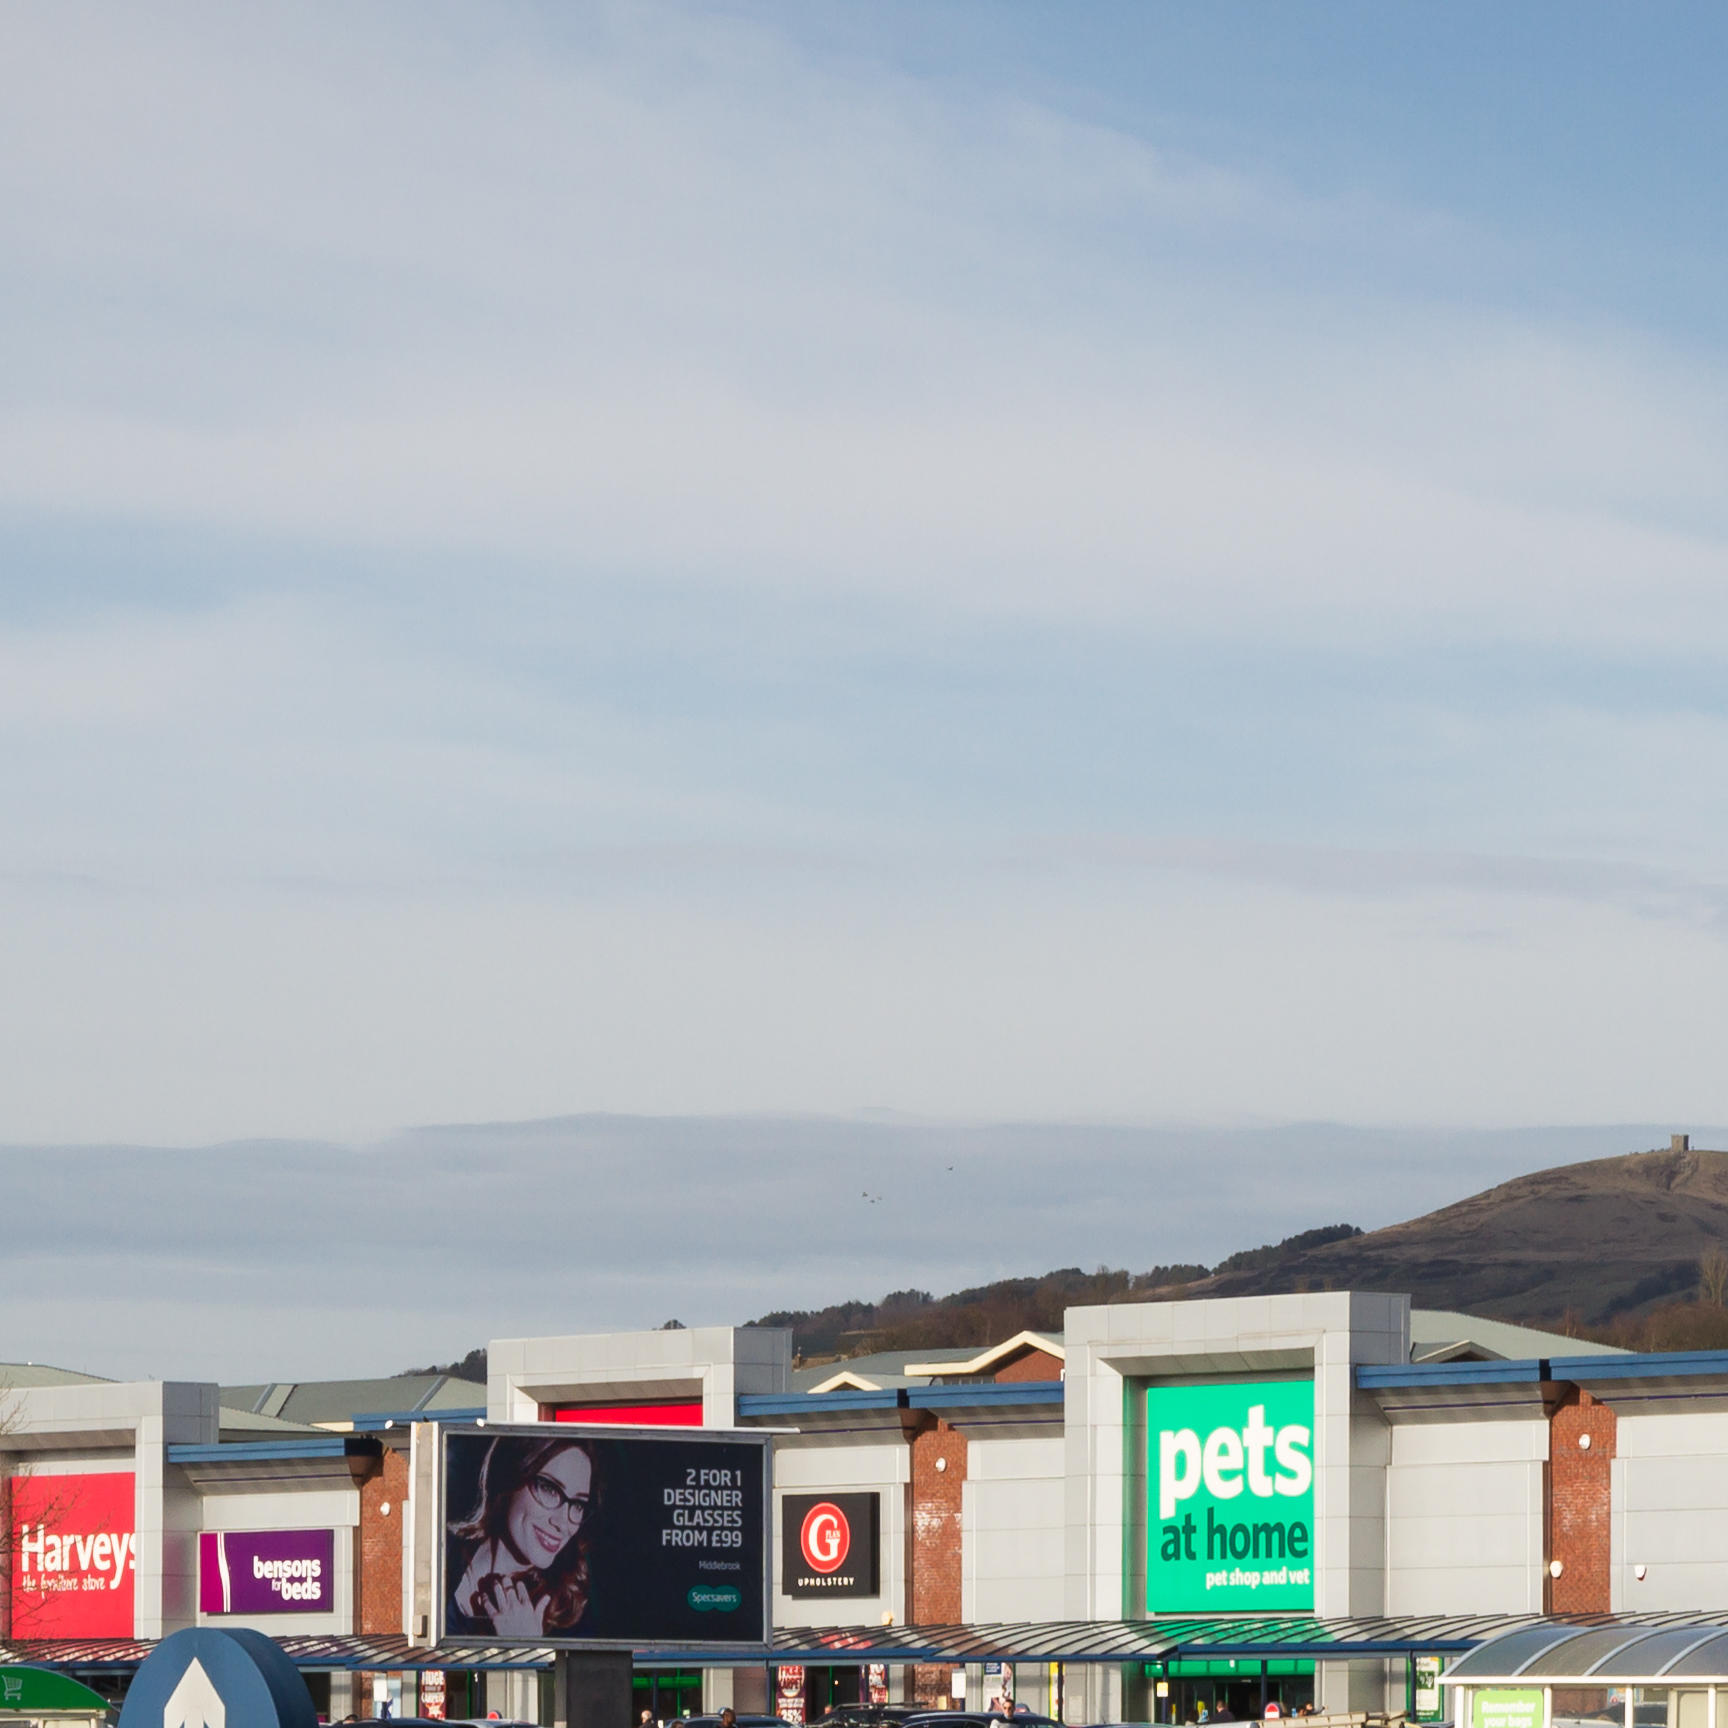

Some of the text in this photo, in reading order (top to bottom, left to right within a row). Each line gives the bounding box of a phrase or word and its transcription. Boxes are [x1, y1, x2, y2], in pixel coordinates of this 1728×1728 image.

[1159, 1404, 1312, 1520] pets
[686, 1469, 742, 1487] 2 FOR 1
[663, 1488, 743, 1507] DESIGNER
[673, 1509, 743, 1527] GLASSES
[661, 1529, 743, 1548] FROM £99
[1160, 1506, 1309, 1562] at home
[253, 1556, 321, 1579] bensons
[1205, 1565, 1310, 1590] pet shop and vet
[281, 1577, 321, 1600] beds
[692, 1591, 737, 1603] Specsavers
[1481, 1701, 1536, 1714] Remember
